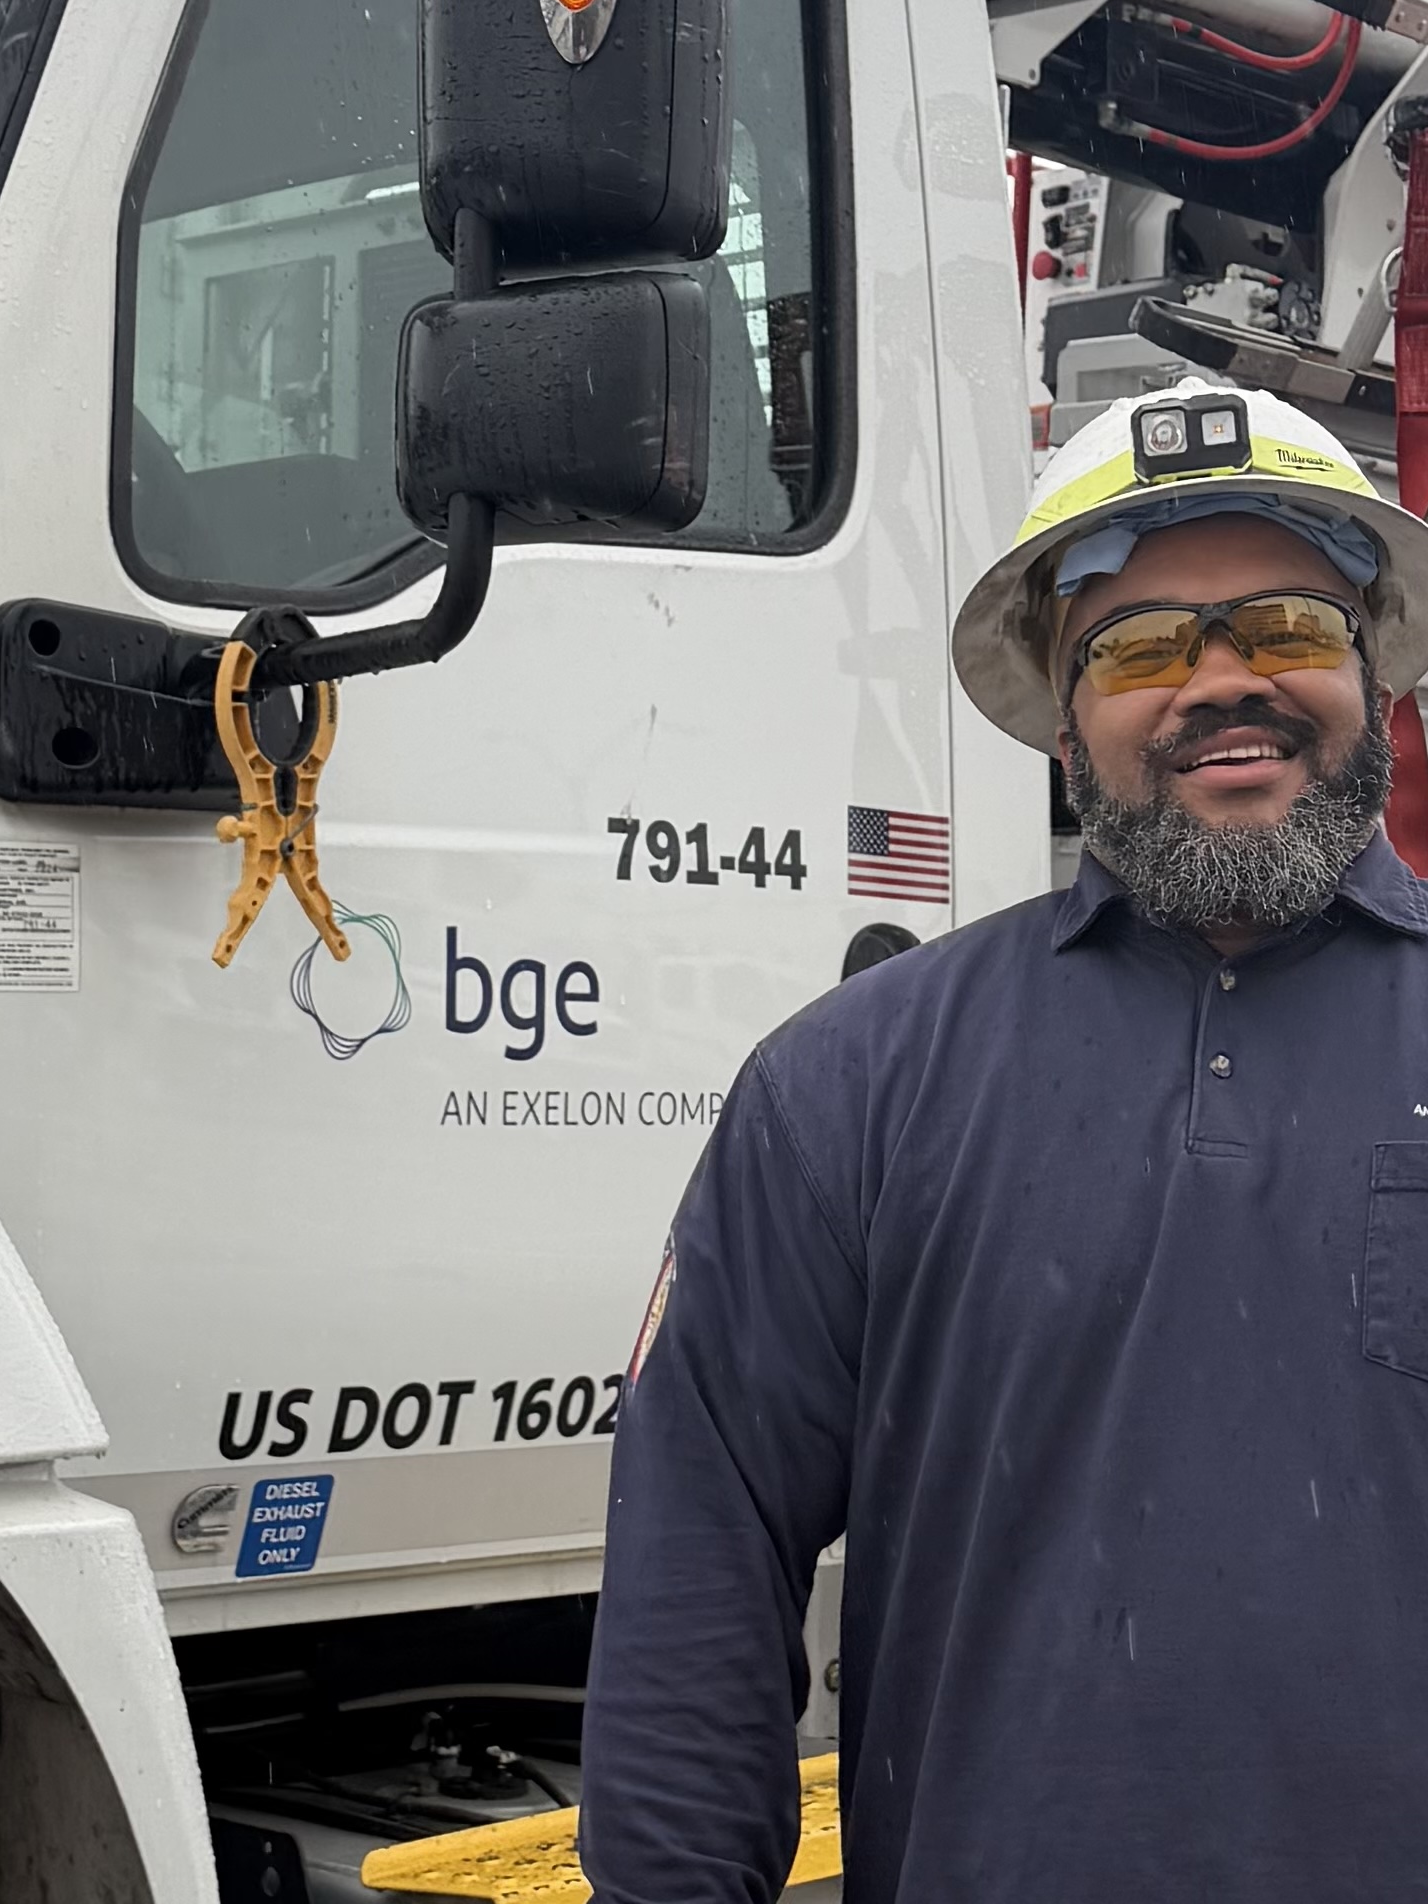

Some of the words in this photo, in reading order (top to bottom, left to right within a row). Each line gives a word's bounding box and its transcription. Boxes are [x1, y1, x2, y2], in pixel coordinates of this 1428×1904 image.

[606, 817, 808, 891] 791-44
[445, 925, 601, 1061] bge
[440, 1089, 487, 1127] AN
[503, 1089, 626, 1127] EXELON
[218, 1388, 314, 1461] US
[327, 1379, 477, 1454] DOT
[265, 1481, 320, 1501] DIESEL
[252, 1502, 325, 1524] EXHAUST
[260, 1525, 306, 1544] FLUID
[257, 1547, 301, 1566] ONLY
